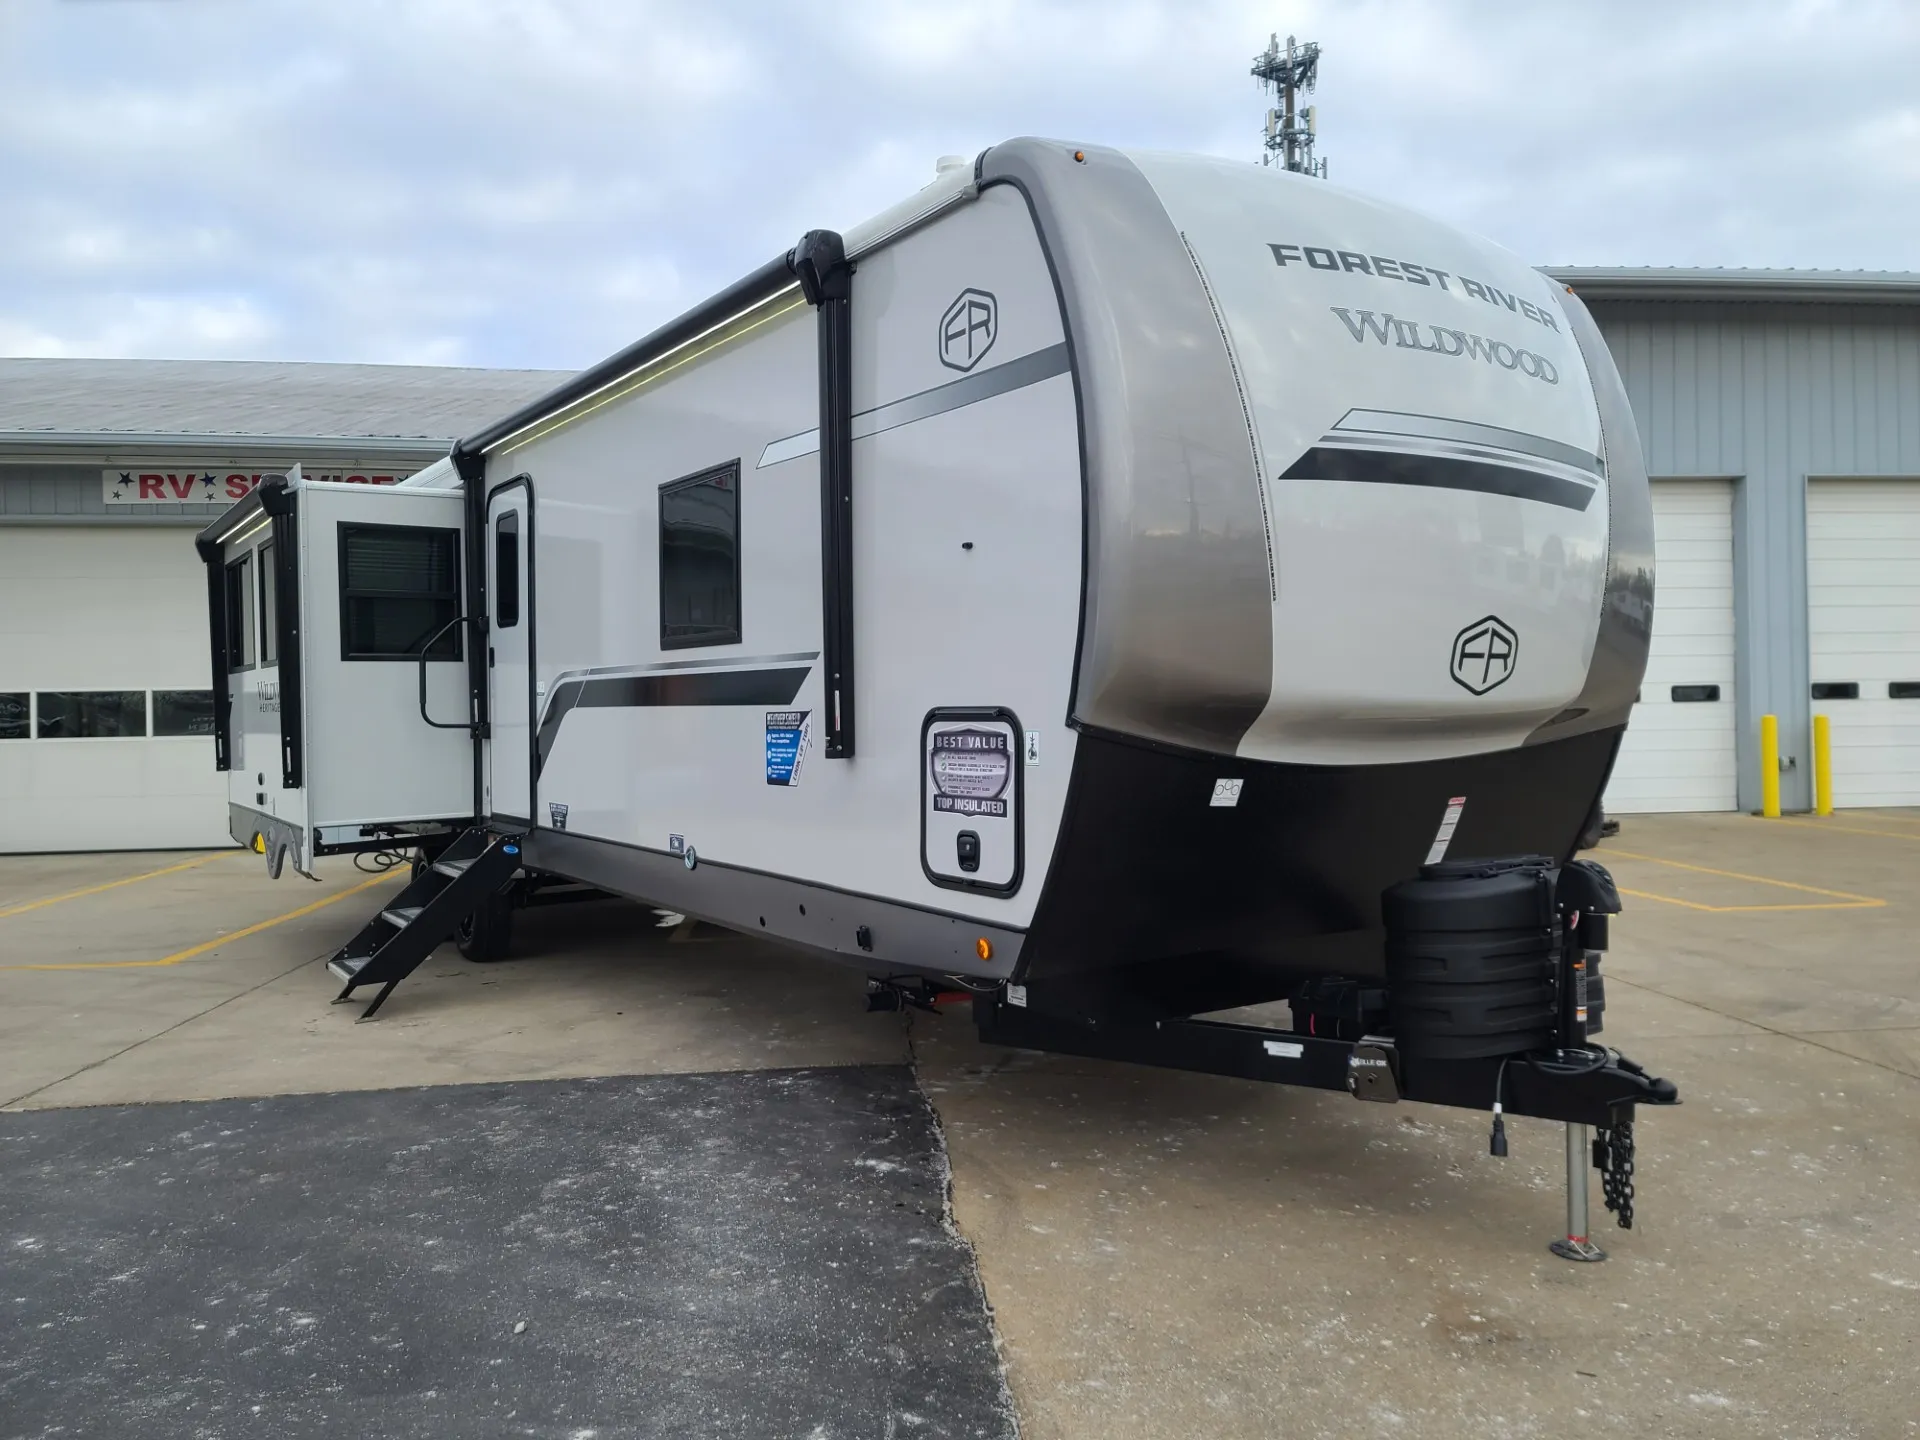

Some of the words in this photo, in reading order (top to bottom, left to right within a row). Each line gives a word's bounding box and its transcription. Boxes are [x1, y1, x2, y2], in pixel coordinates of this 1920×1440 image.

[1266, 243, 1450, 291] FOREST
[1457, 275, 1562, 334] RIVER
[1330, 306, 1559, 385] WILDWOOD
[139, 474, 196, 499] RV
[936, 736, 962, 748] BEST
[968, 736, 1004, 749] VALUE
[936, 797, 953, 809] TOP
[955, 799, 1004, 814] INSULATED
